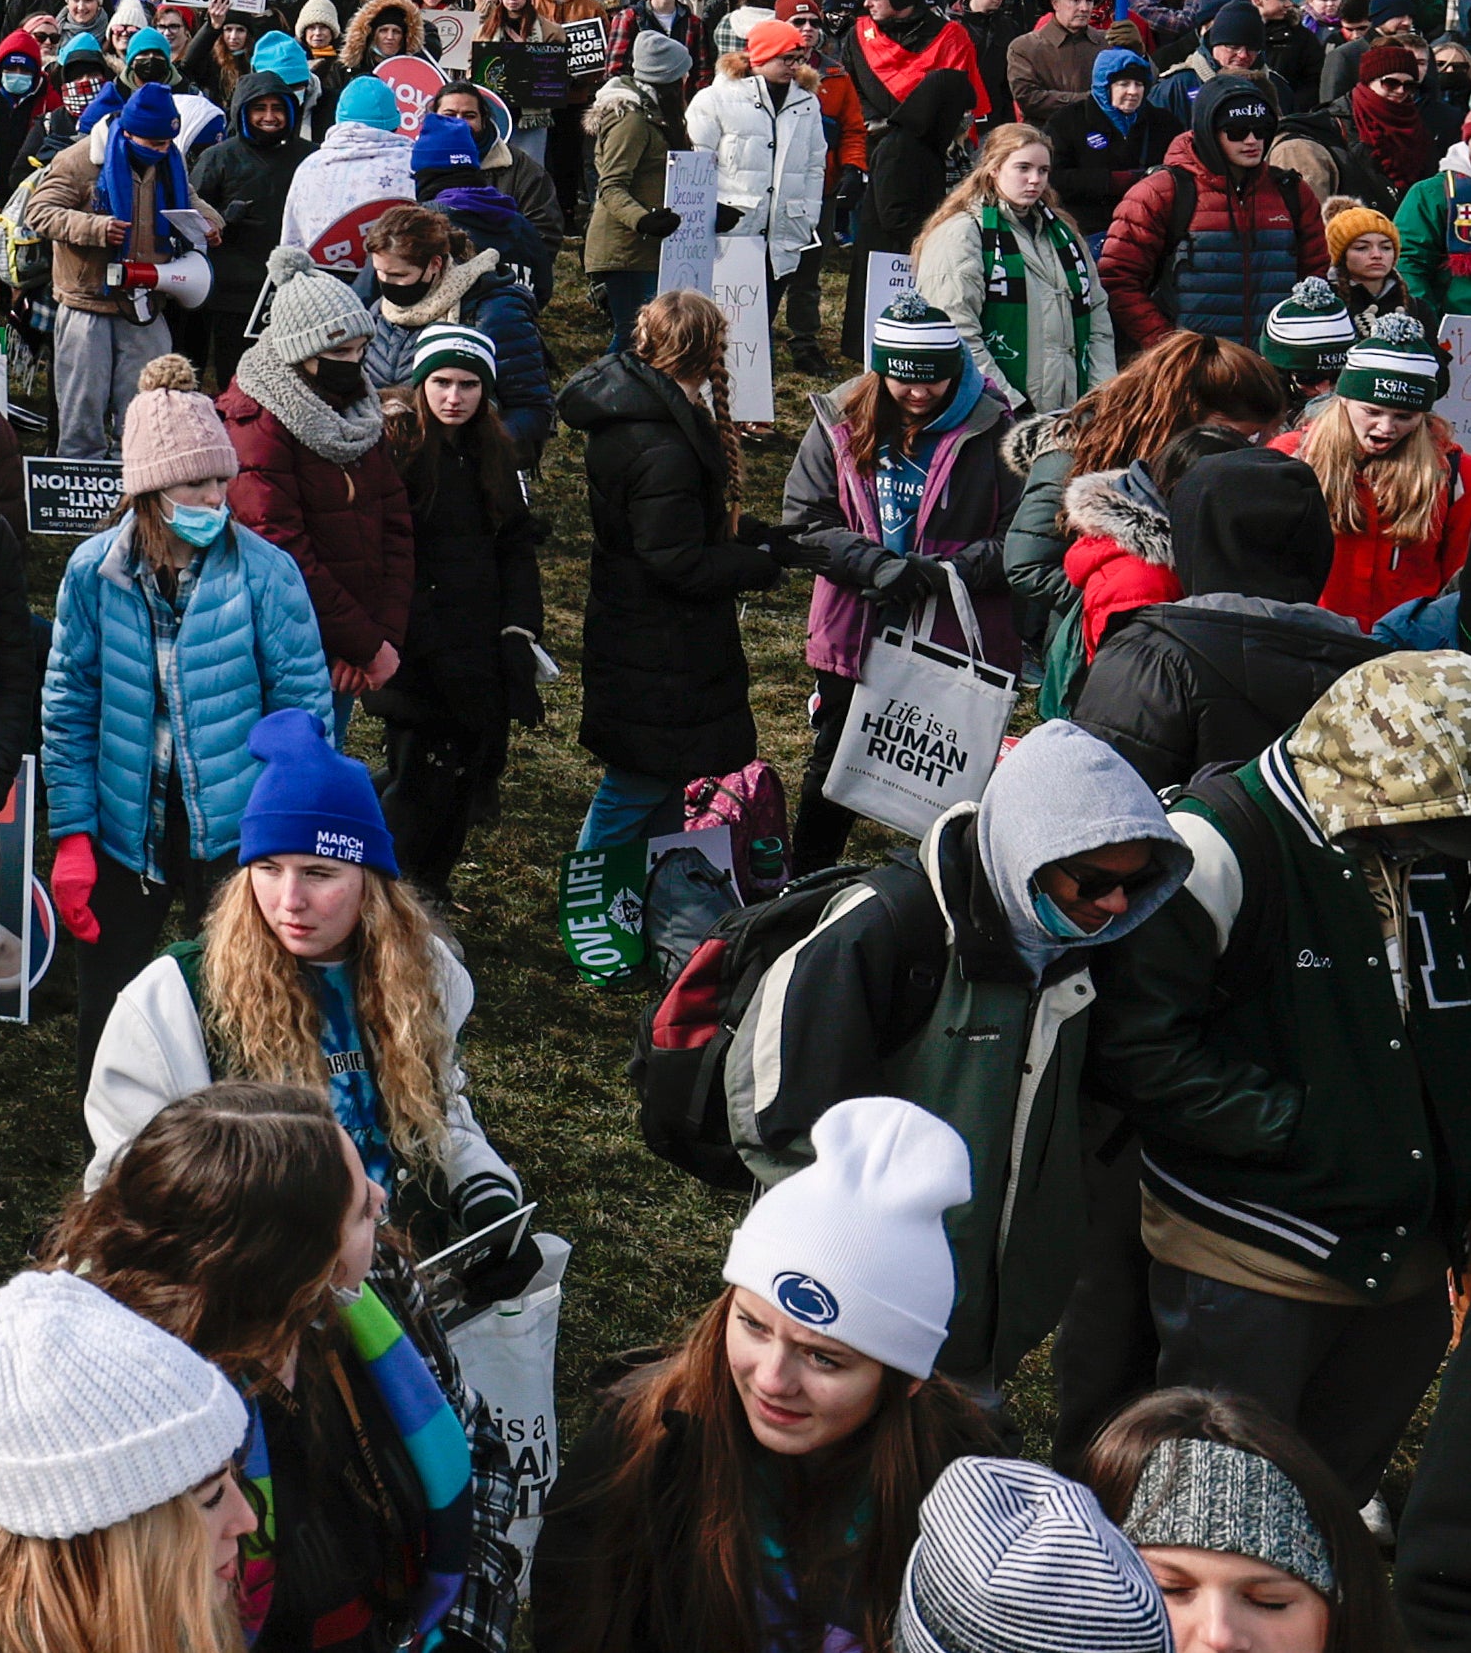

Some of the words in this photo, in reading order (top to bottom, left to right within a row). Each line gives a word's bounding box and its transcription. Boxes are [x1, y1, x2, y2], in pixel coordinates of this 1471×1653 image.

[568, 30, 597, 42] THE
[673, 186, 705, 205] Because
[889, 277, 904, 288] an
[880, 698, 922, 727] Life
[923, 714, 944, 739] is
[945, 729, 958, 745] a
[860, 712, 968, 773] HUMAN
[866, 739, 954, 788] RIGHT
[845, 764, 882, 783] ALLIANCE
[883, 779, 923, 801] DEFENDING
[315, 842, 336, 857] for
[337, 846, 364, 863] LIFE
[316, 830, 364, 851] MARCH
[567, 851, 606, 905] LIFE
[567, 908, 612, 982] OVE
